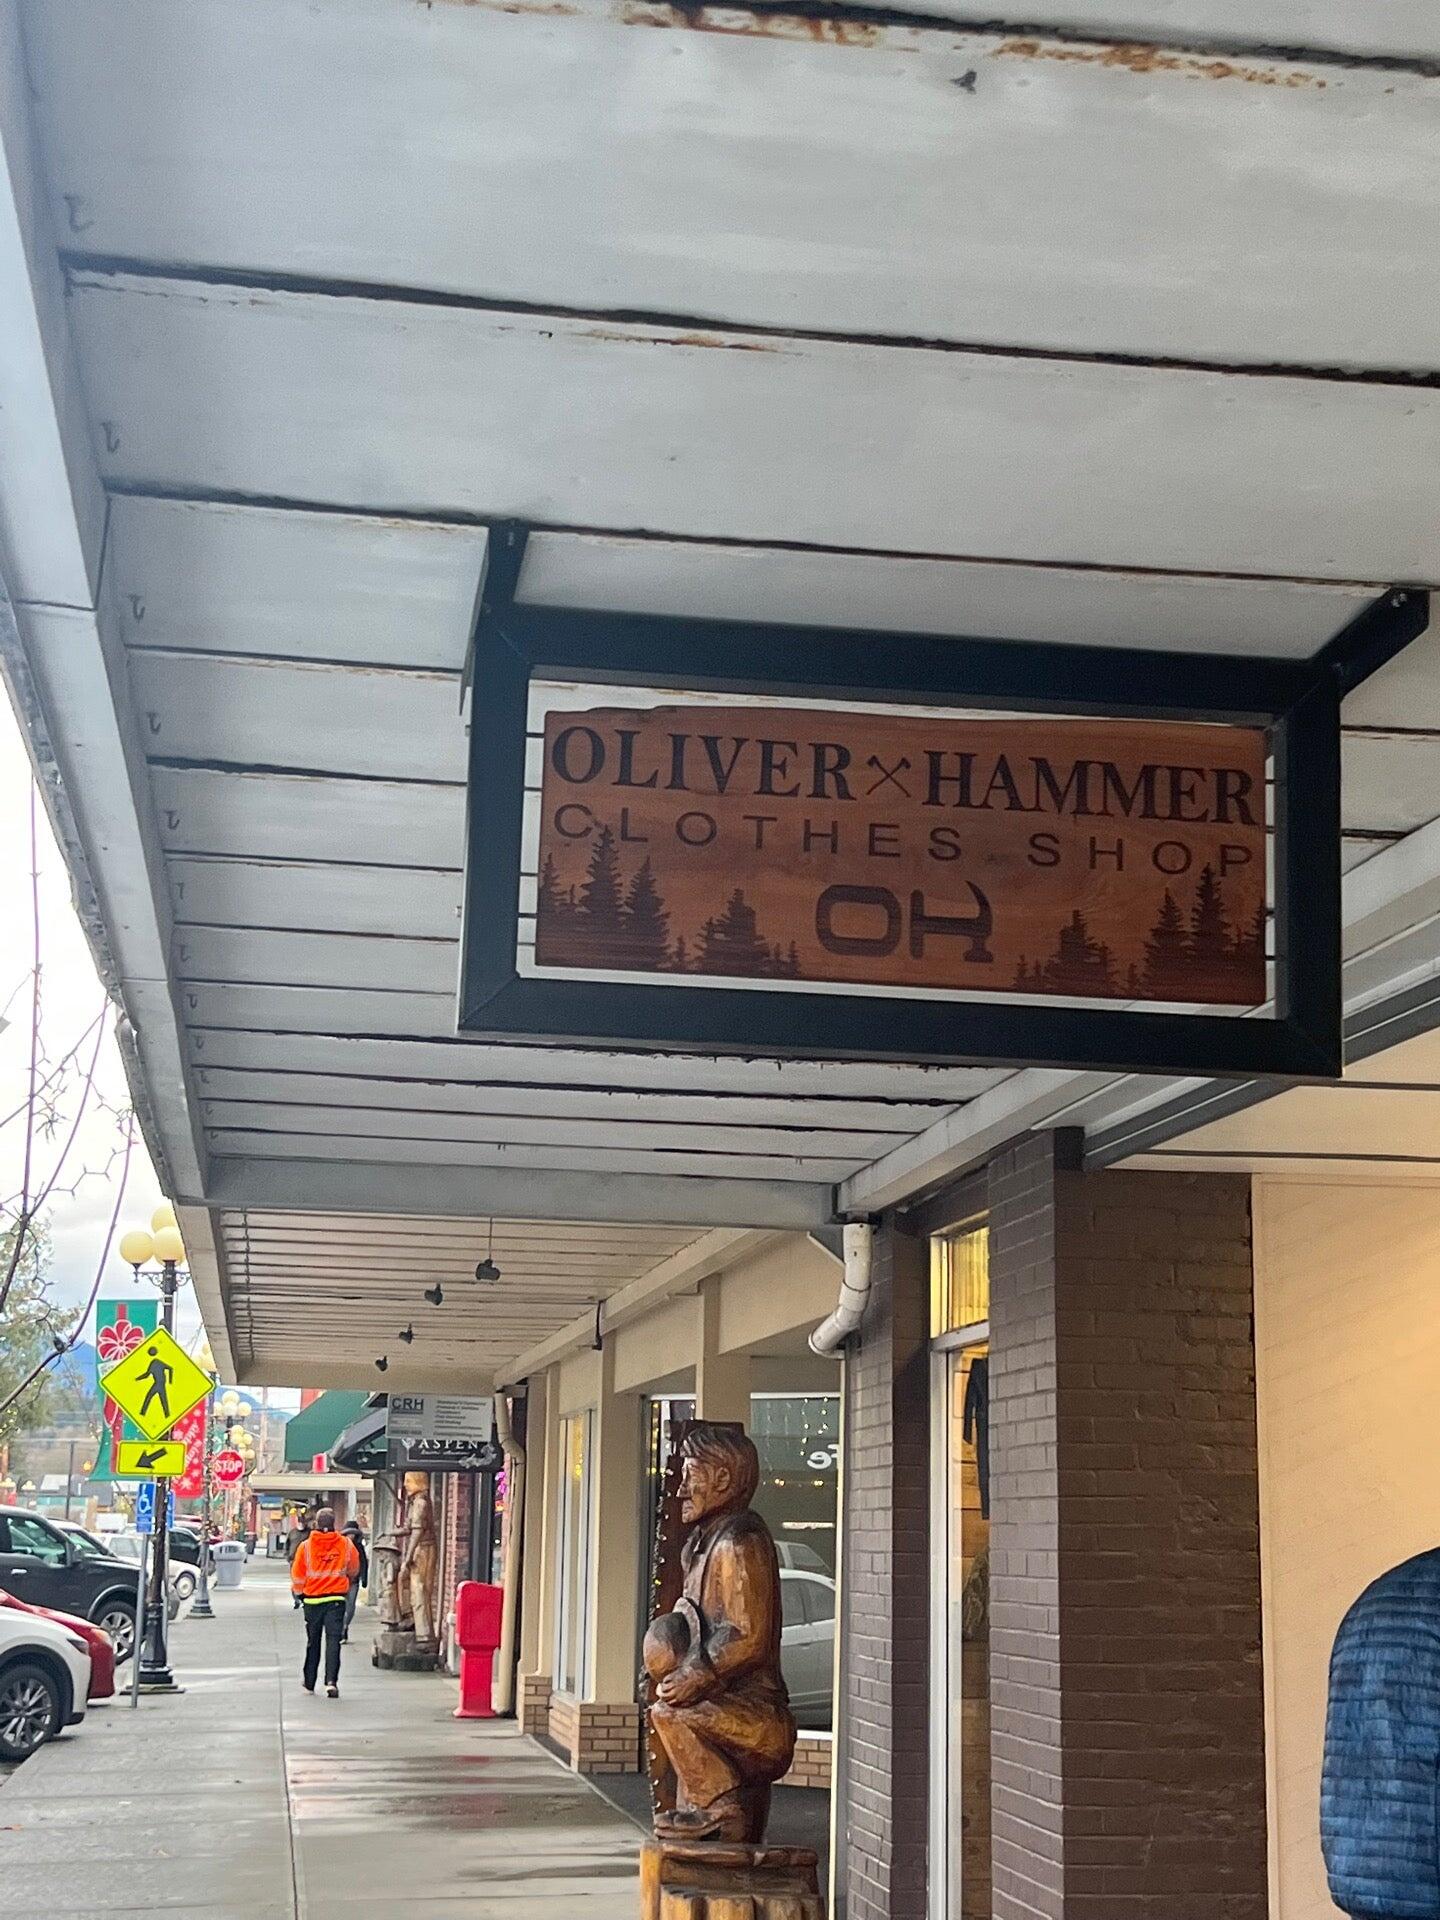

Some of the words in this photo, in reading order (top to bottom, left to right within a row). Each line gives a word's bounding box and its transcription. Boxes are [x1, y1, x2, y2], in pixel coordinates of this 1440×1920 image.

[550, 725, 857, 801] OLIVER
[922, 748, 1257, 826] HAMMER
[553, 802, 962, 862] CLOTHES
[1028, 832, 1253, 878] SHOP
[391, 1397, 424, 1411] CRH
[418, 1438, 478, 1450] ASPEN
[214, 1460, 242, 1473] STOP
